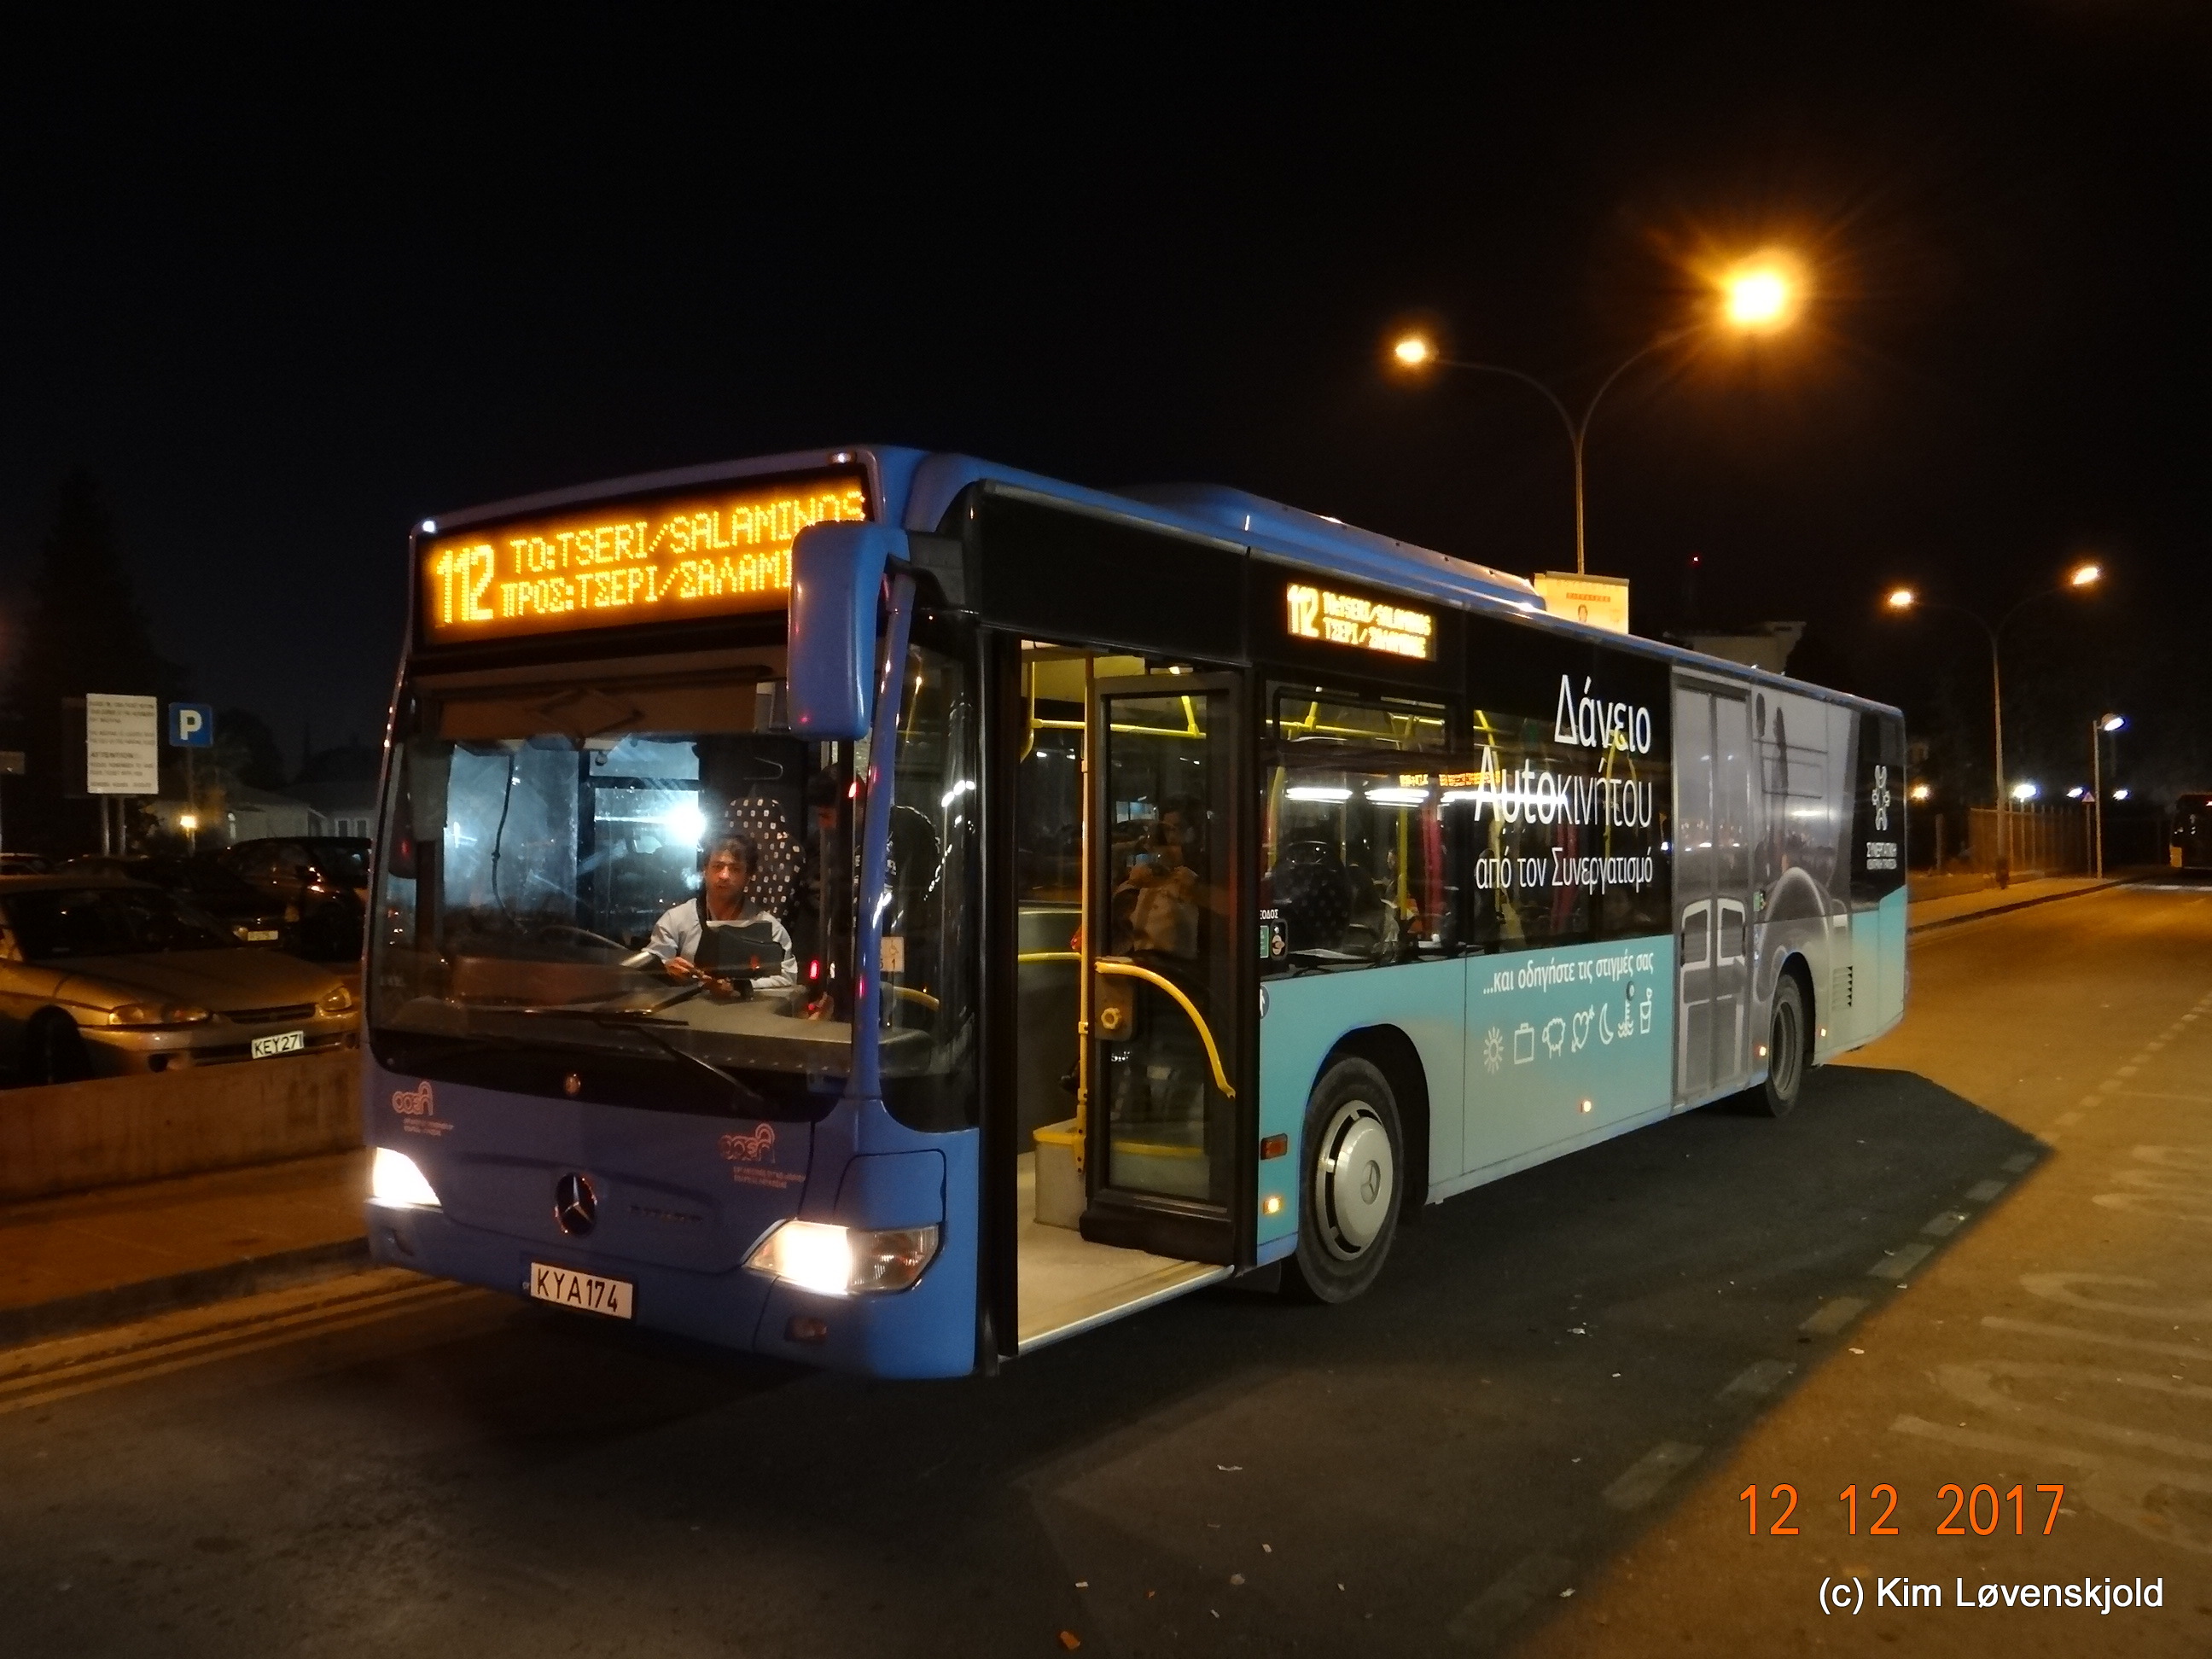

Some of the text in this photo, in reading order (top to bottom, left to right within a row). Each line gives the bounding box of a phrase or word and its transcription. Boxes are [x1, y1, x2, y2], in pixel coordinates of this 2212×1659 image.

[436, 544, 494, 623] 112
[500, 549, 792, 618] ΠΡΟΣ:ΤΣΕΡΙ/ΣΑΛΑΜΙ
[180, 709, 202, 741] P
[1554, 674, 1651, 754] Δάνειο
[1476, 846, 1653, 894] από τον Συνεργατισμό
[1518, 956, 1575, 992] οδηγήστε
[1579, 959, 1593, 983] τις
[1596, 948, 1633, 981] στιγμές
[1636, 952, 1654, 974] σας
[537, 1267, 618, 1313] KYA174
